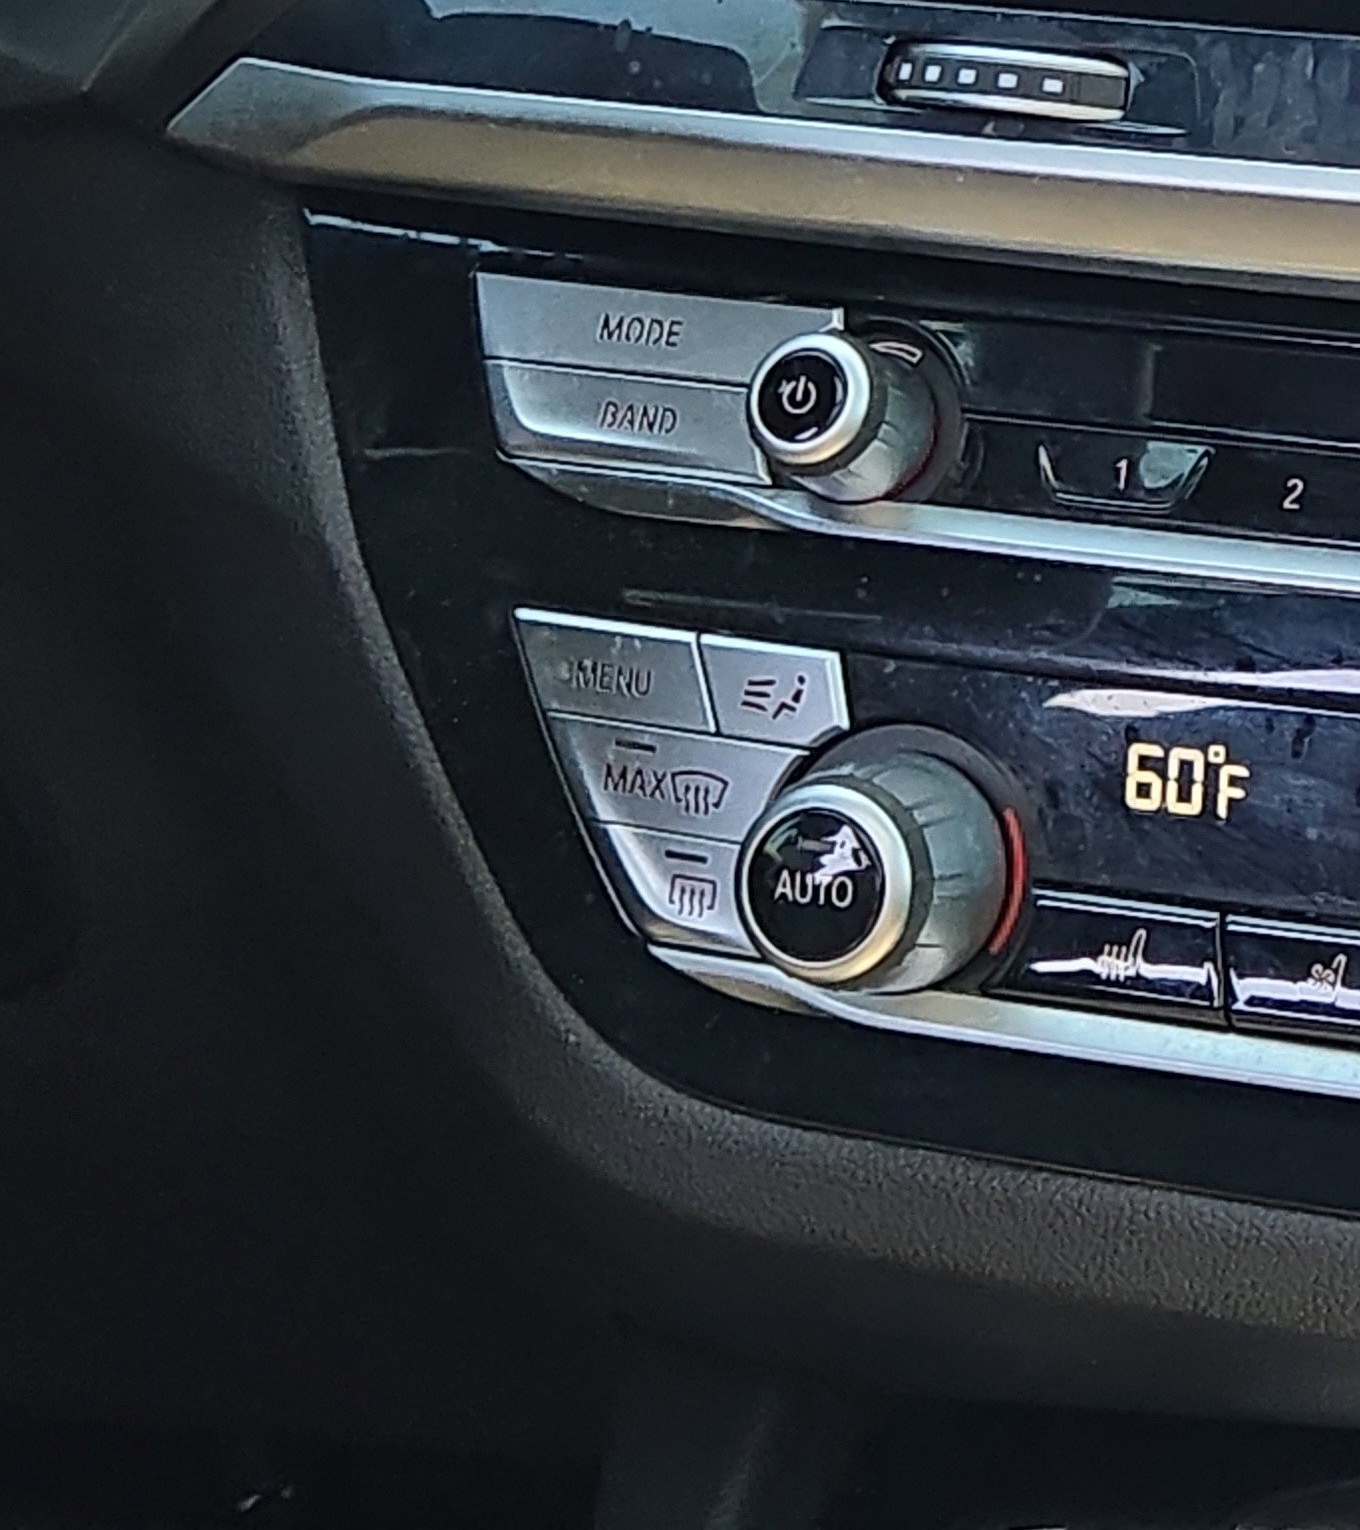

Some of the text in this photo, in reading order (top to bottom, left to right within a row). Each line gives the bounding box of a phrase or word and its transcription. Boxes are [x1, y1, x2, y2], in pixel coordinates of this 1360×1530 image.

[599, 313, 684, 348] MODE
[600, 400, 680, 435] BAND
[1114, 458, 1129, 489] 1
[1282, 479, 1304, 511] 2
[572, 659, 652, 698] MENU
[603, 765, 667, 799] MAX
[773, 870, 853, 908] AUTO
